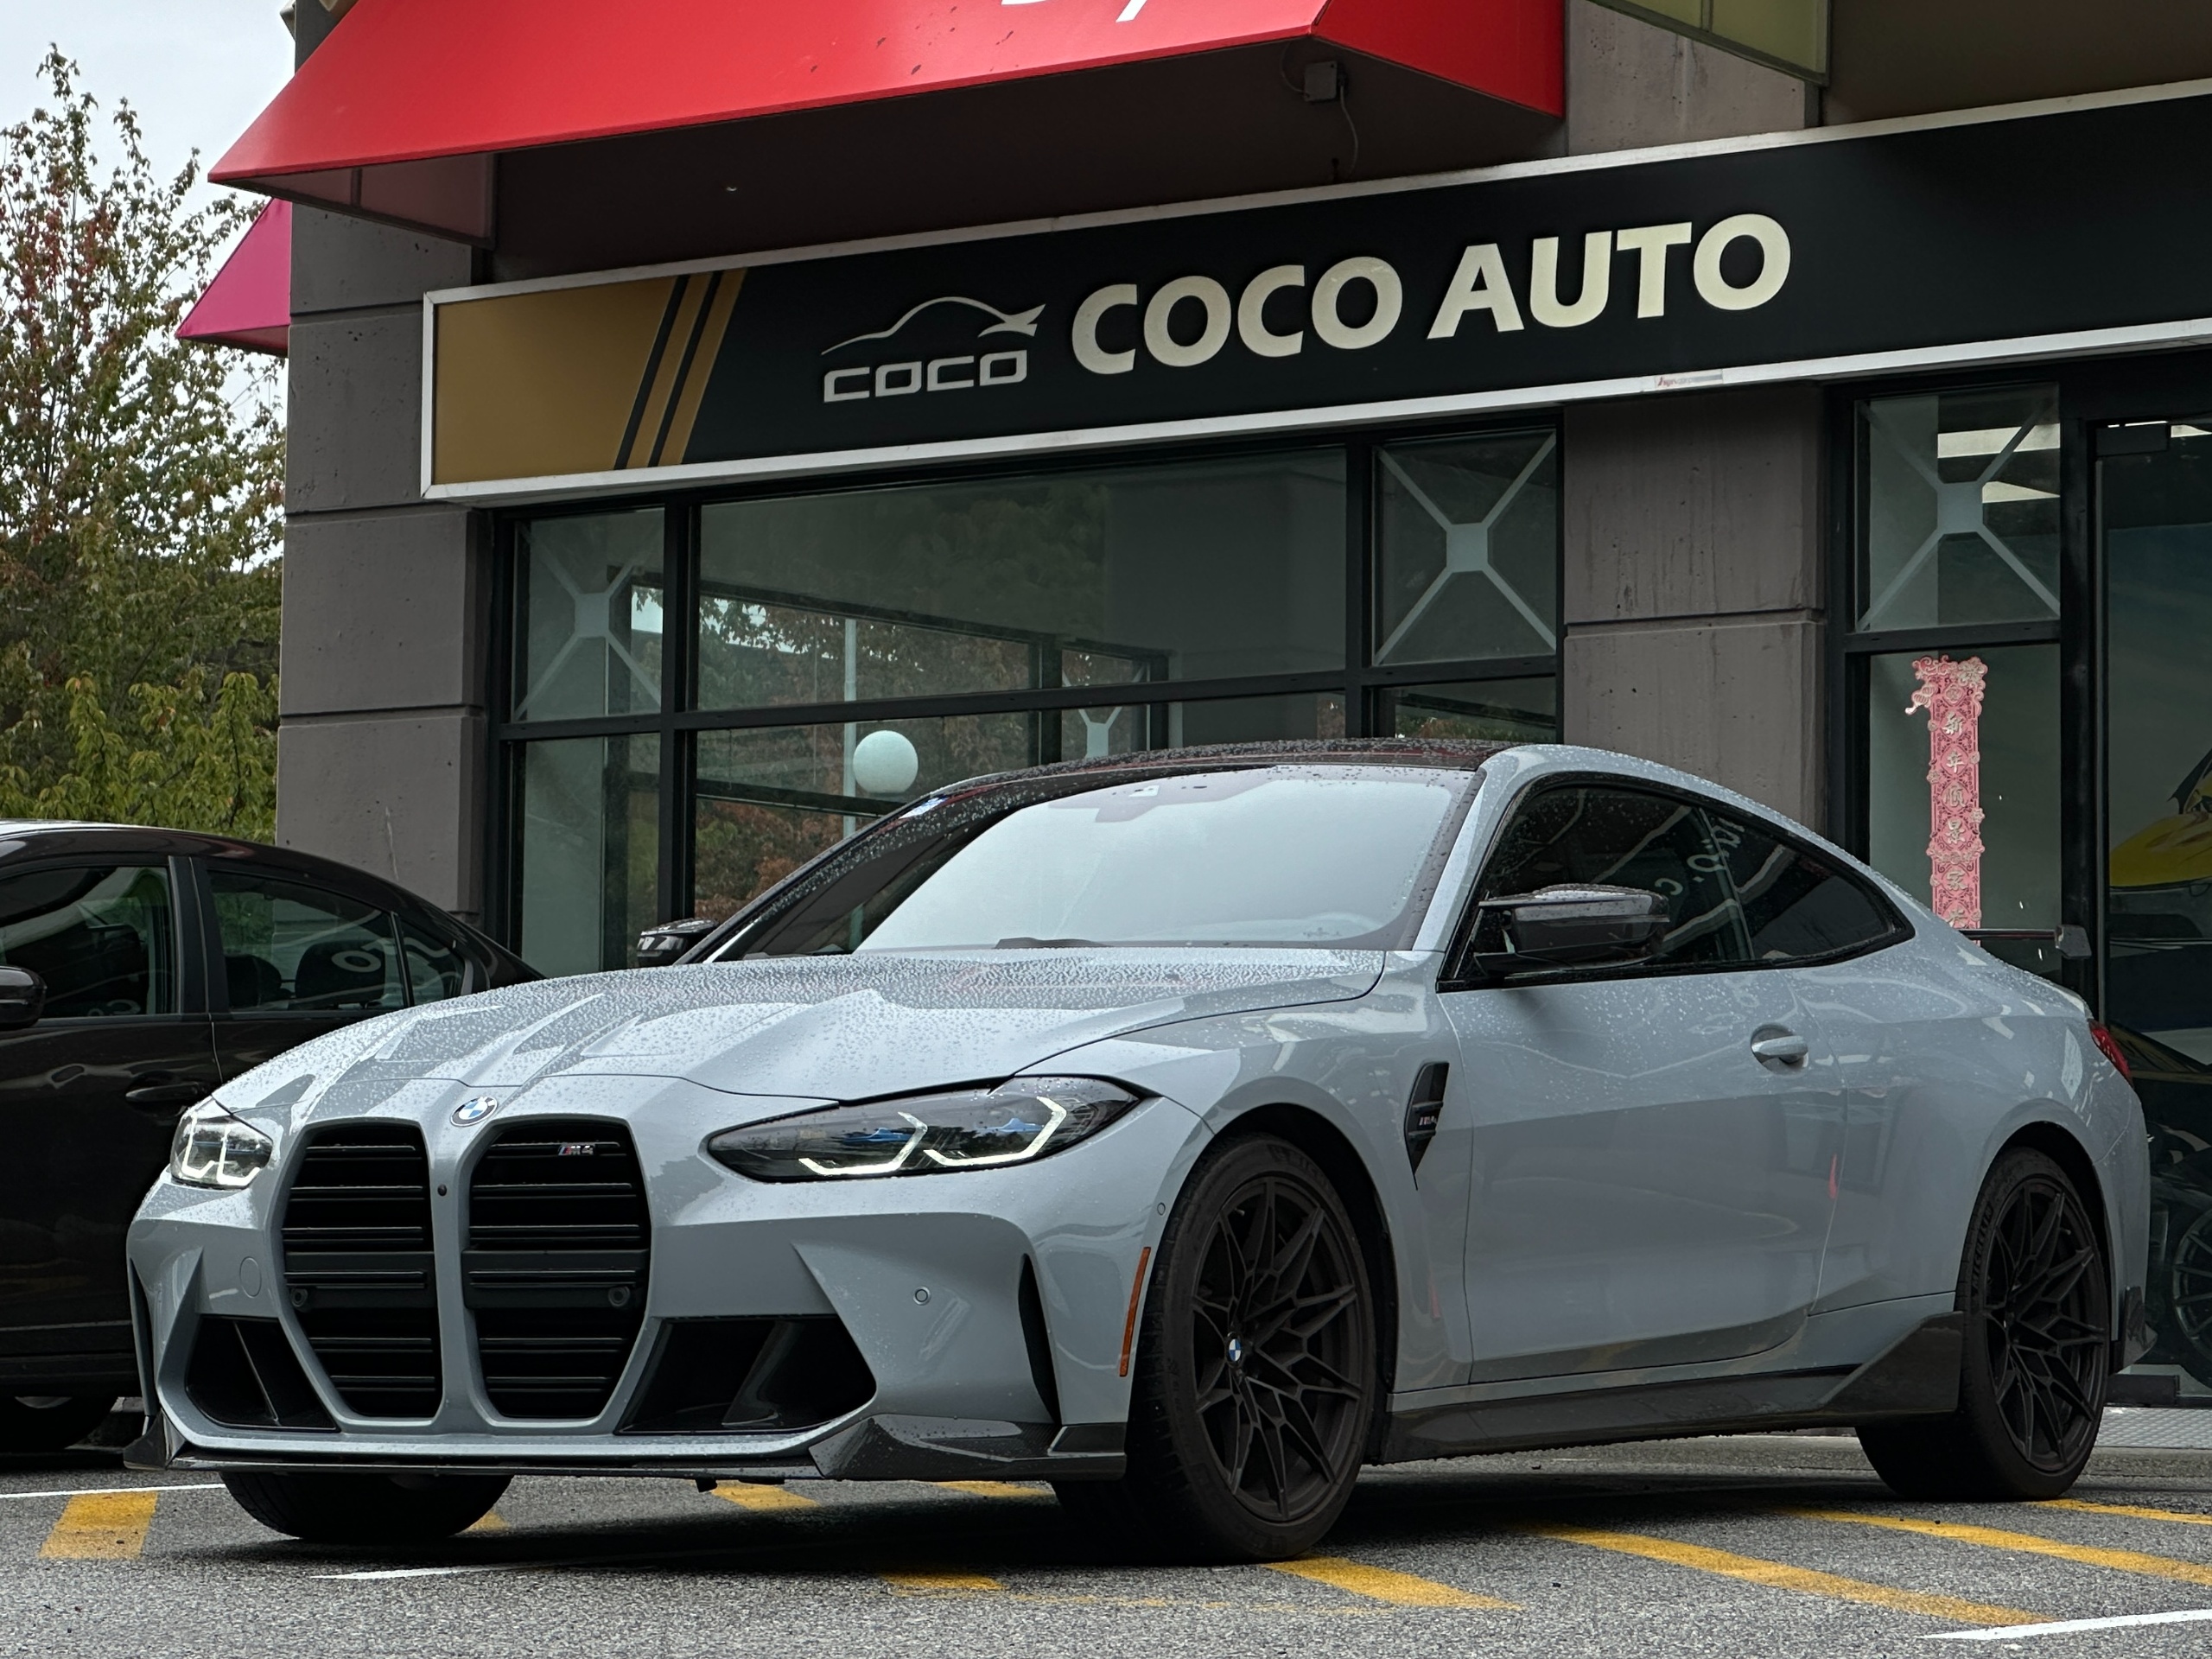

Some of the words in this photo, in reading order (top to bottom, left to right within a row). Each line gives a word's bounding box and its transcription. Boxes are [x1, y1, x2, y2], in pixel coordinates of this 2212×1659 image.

[1071, 256, 1404, 375] COCO
[1427, 213, 1792, 340] AUTO
[823, 349, 1027, 403] COCO
